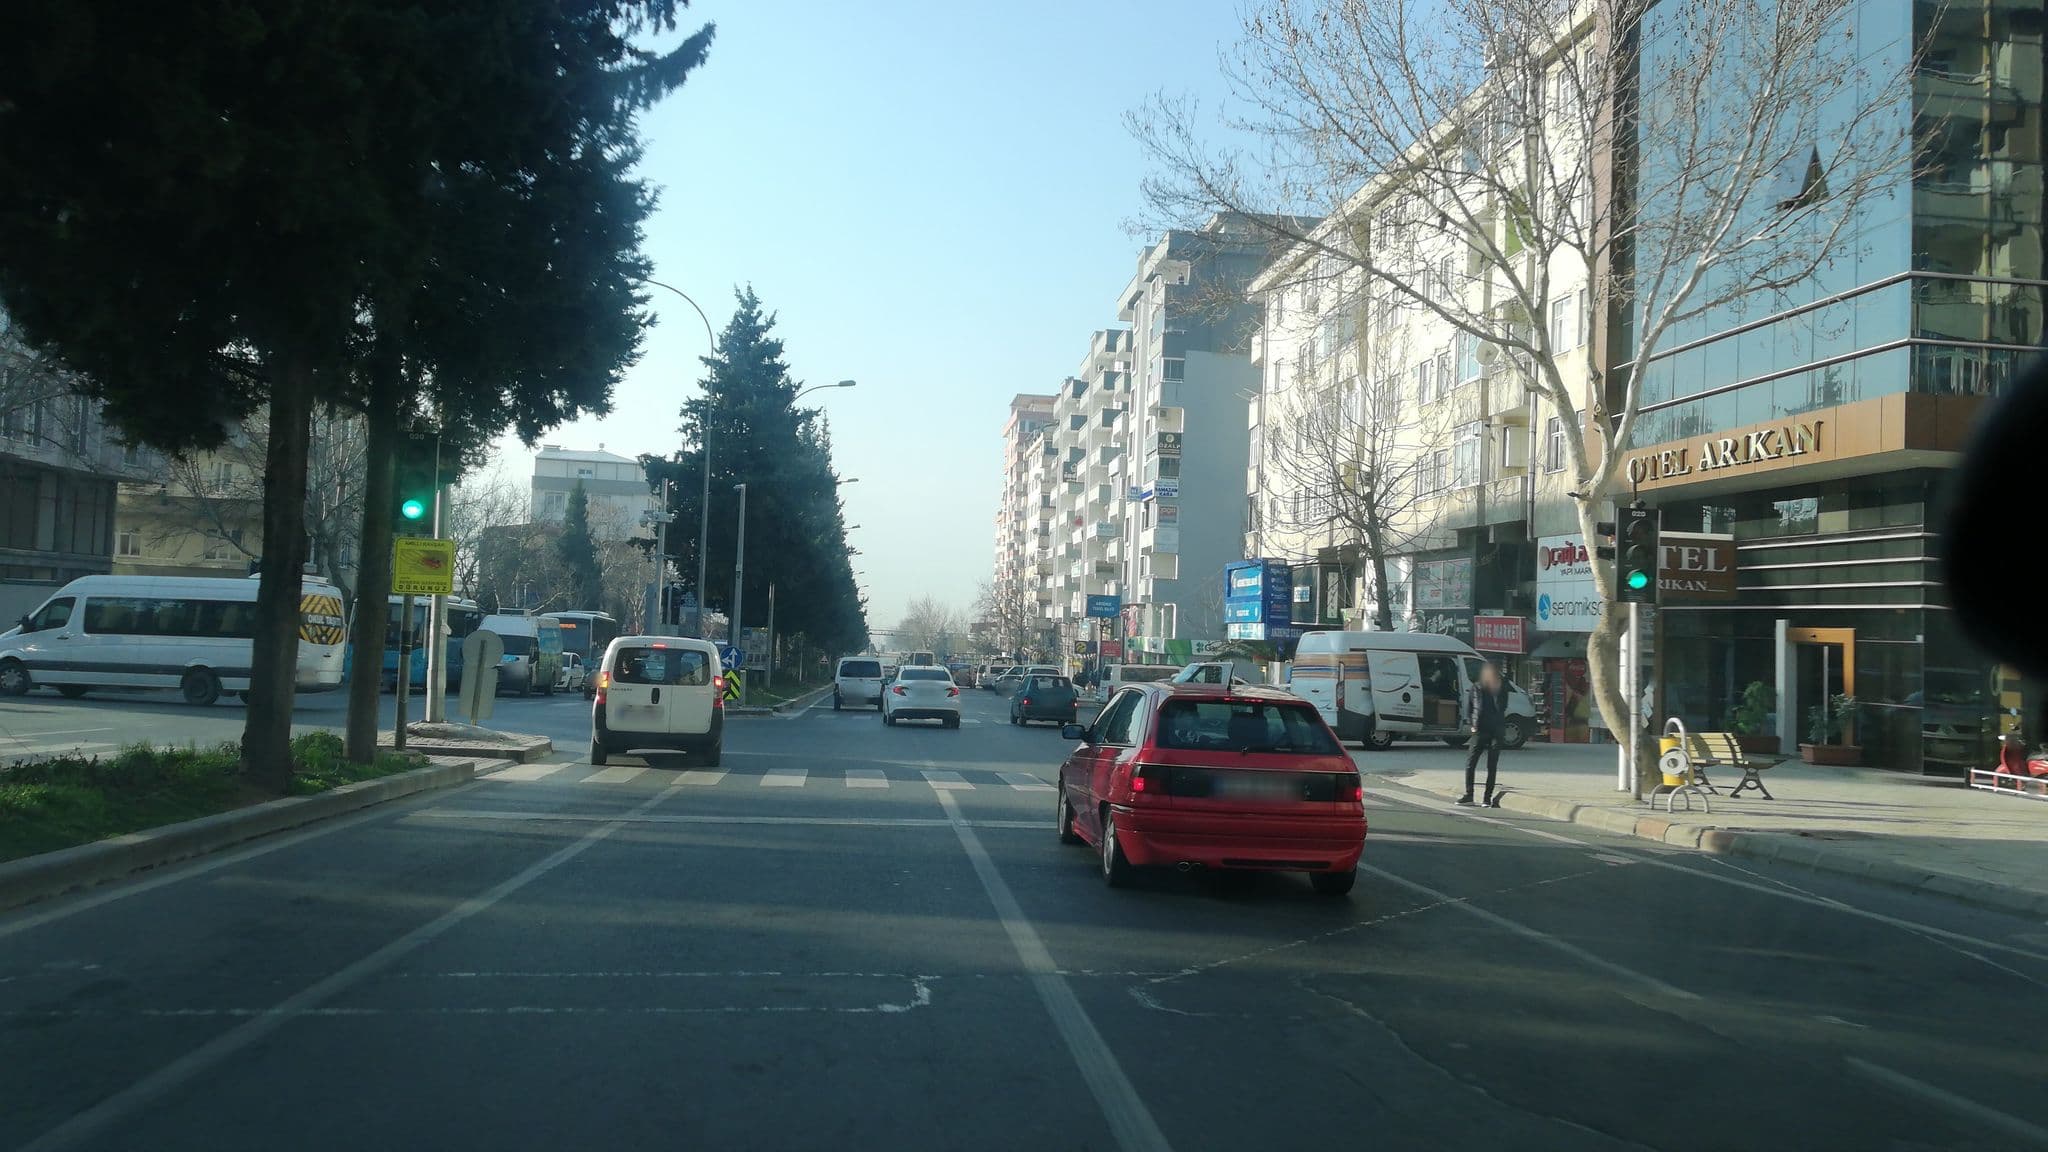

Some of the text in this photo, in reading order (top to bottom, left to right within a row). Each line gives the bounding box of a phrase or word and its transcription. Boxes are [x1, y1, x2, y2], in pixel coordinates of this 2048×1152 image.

[1626, 420, 1824, 484] OTEL ARIKAN
[1658, 545, 1728, 572] TEL
[1657, 578, 1709, 591] RIKAN
[1552, 597, 1602, 616] seramiks
[308, 614, 325, 625] OKUL
[1494, 624, 1520, 640] MARKET
